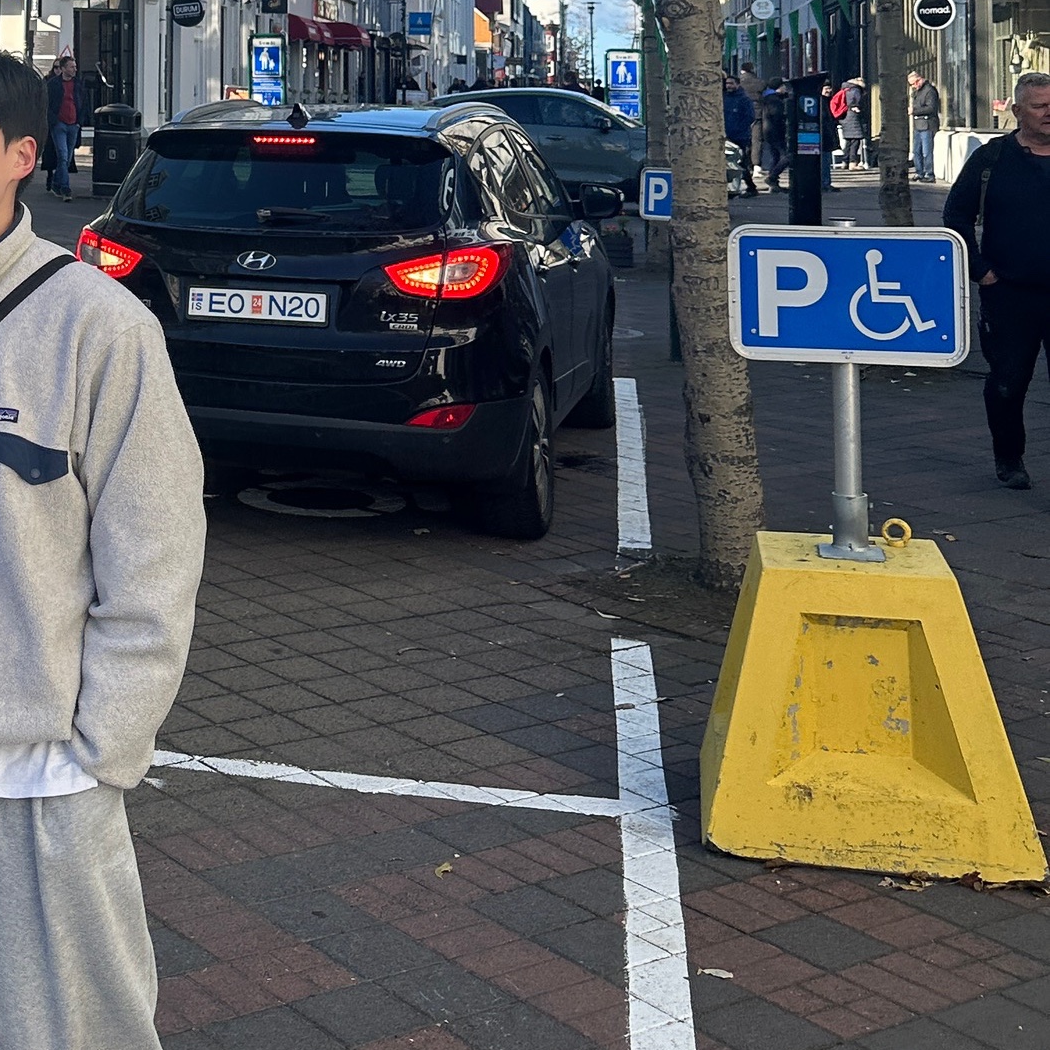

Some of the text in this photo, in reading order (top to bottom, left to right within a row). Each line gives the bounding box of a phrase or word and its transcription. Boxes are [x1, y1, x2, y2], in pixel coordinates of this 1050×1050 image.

[648, 176, 669, 212] P
[191, 292, 320, 319] IS EO 24 N20
[756, 248, 829, 338] P
[380, 310, 419, 323] ix35
[375, 359, 407, 368] 4WD
